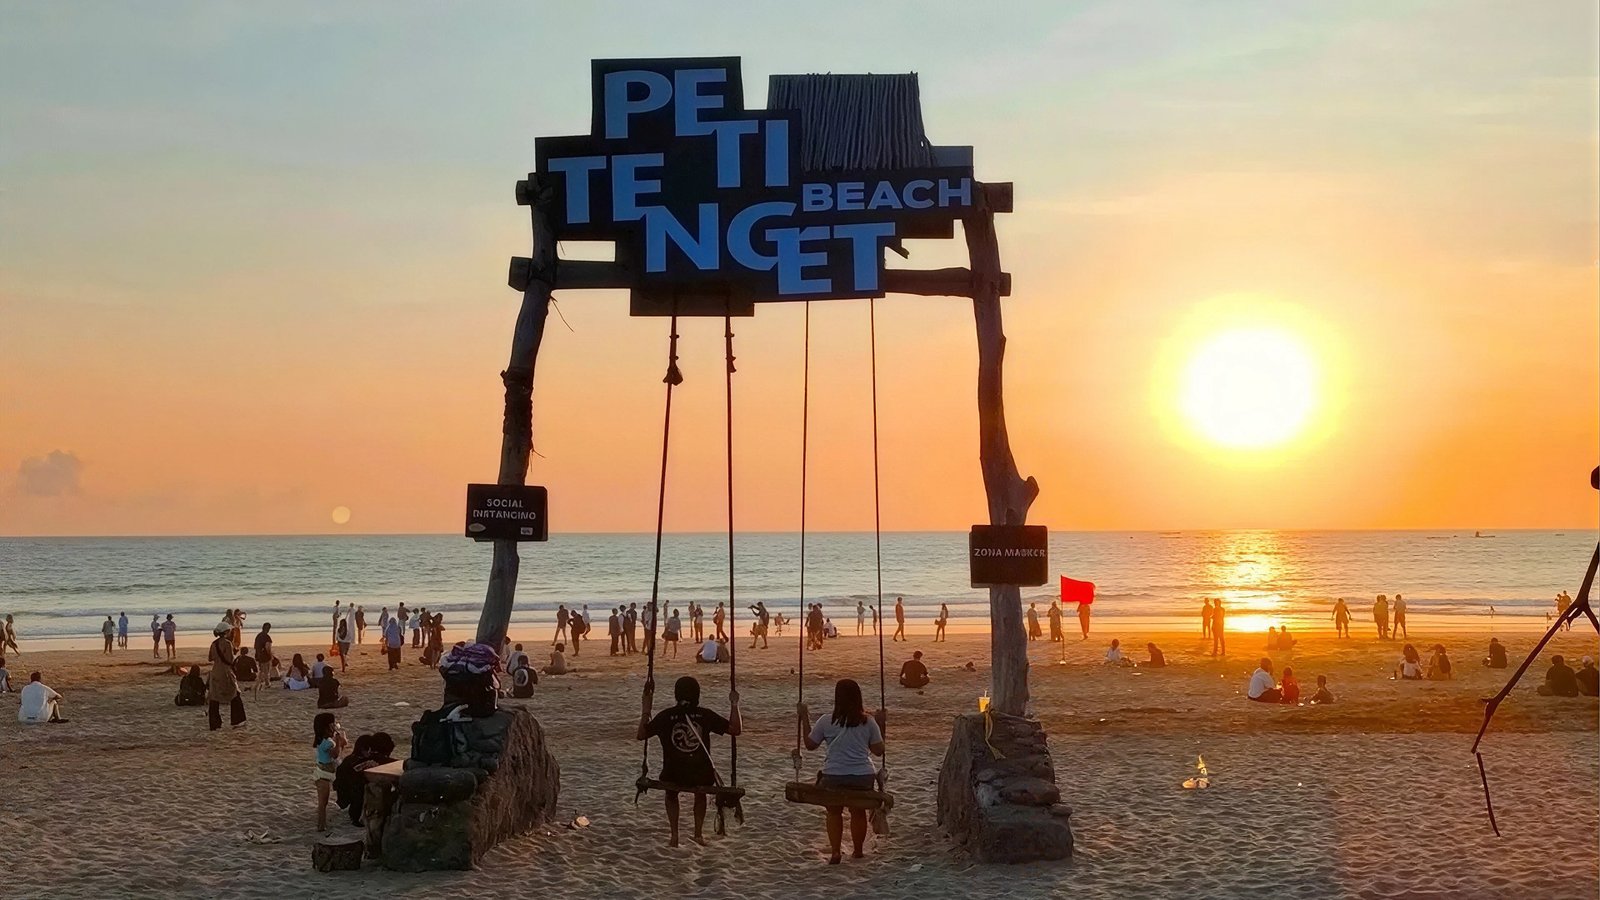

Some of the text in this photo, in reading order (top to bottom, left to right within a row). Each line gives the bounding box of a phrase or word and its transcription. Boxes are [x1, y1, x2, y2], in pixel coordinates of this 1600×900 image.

[604, 68, 727, 139] PE
[802, 178, 972, 212] BEACH
[486, 498, 524, 508] SOCIAL
[974, 548, 1002, 557] ZONA
